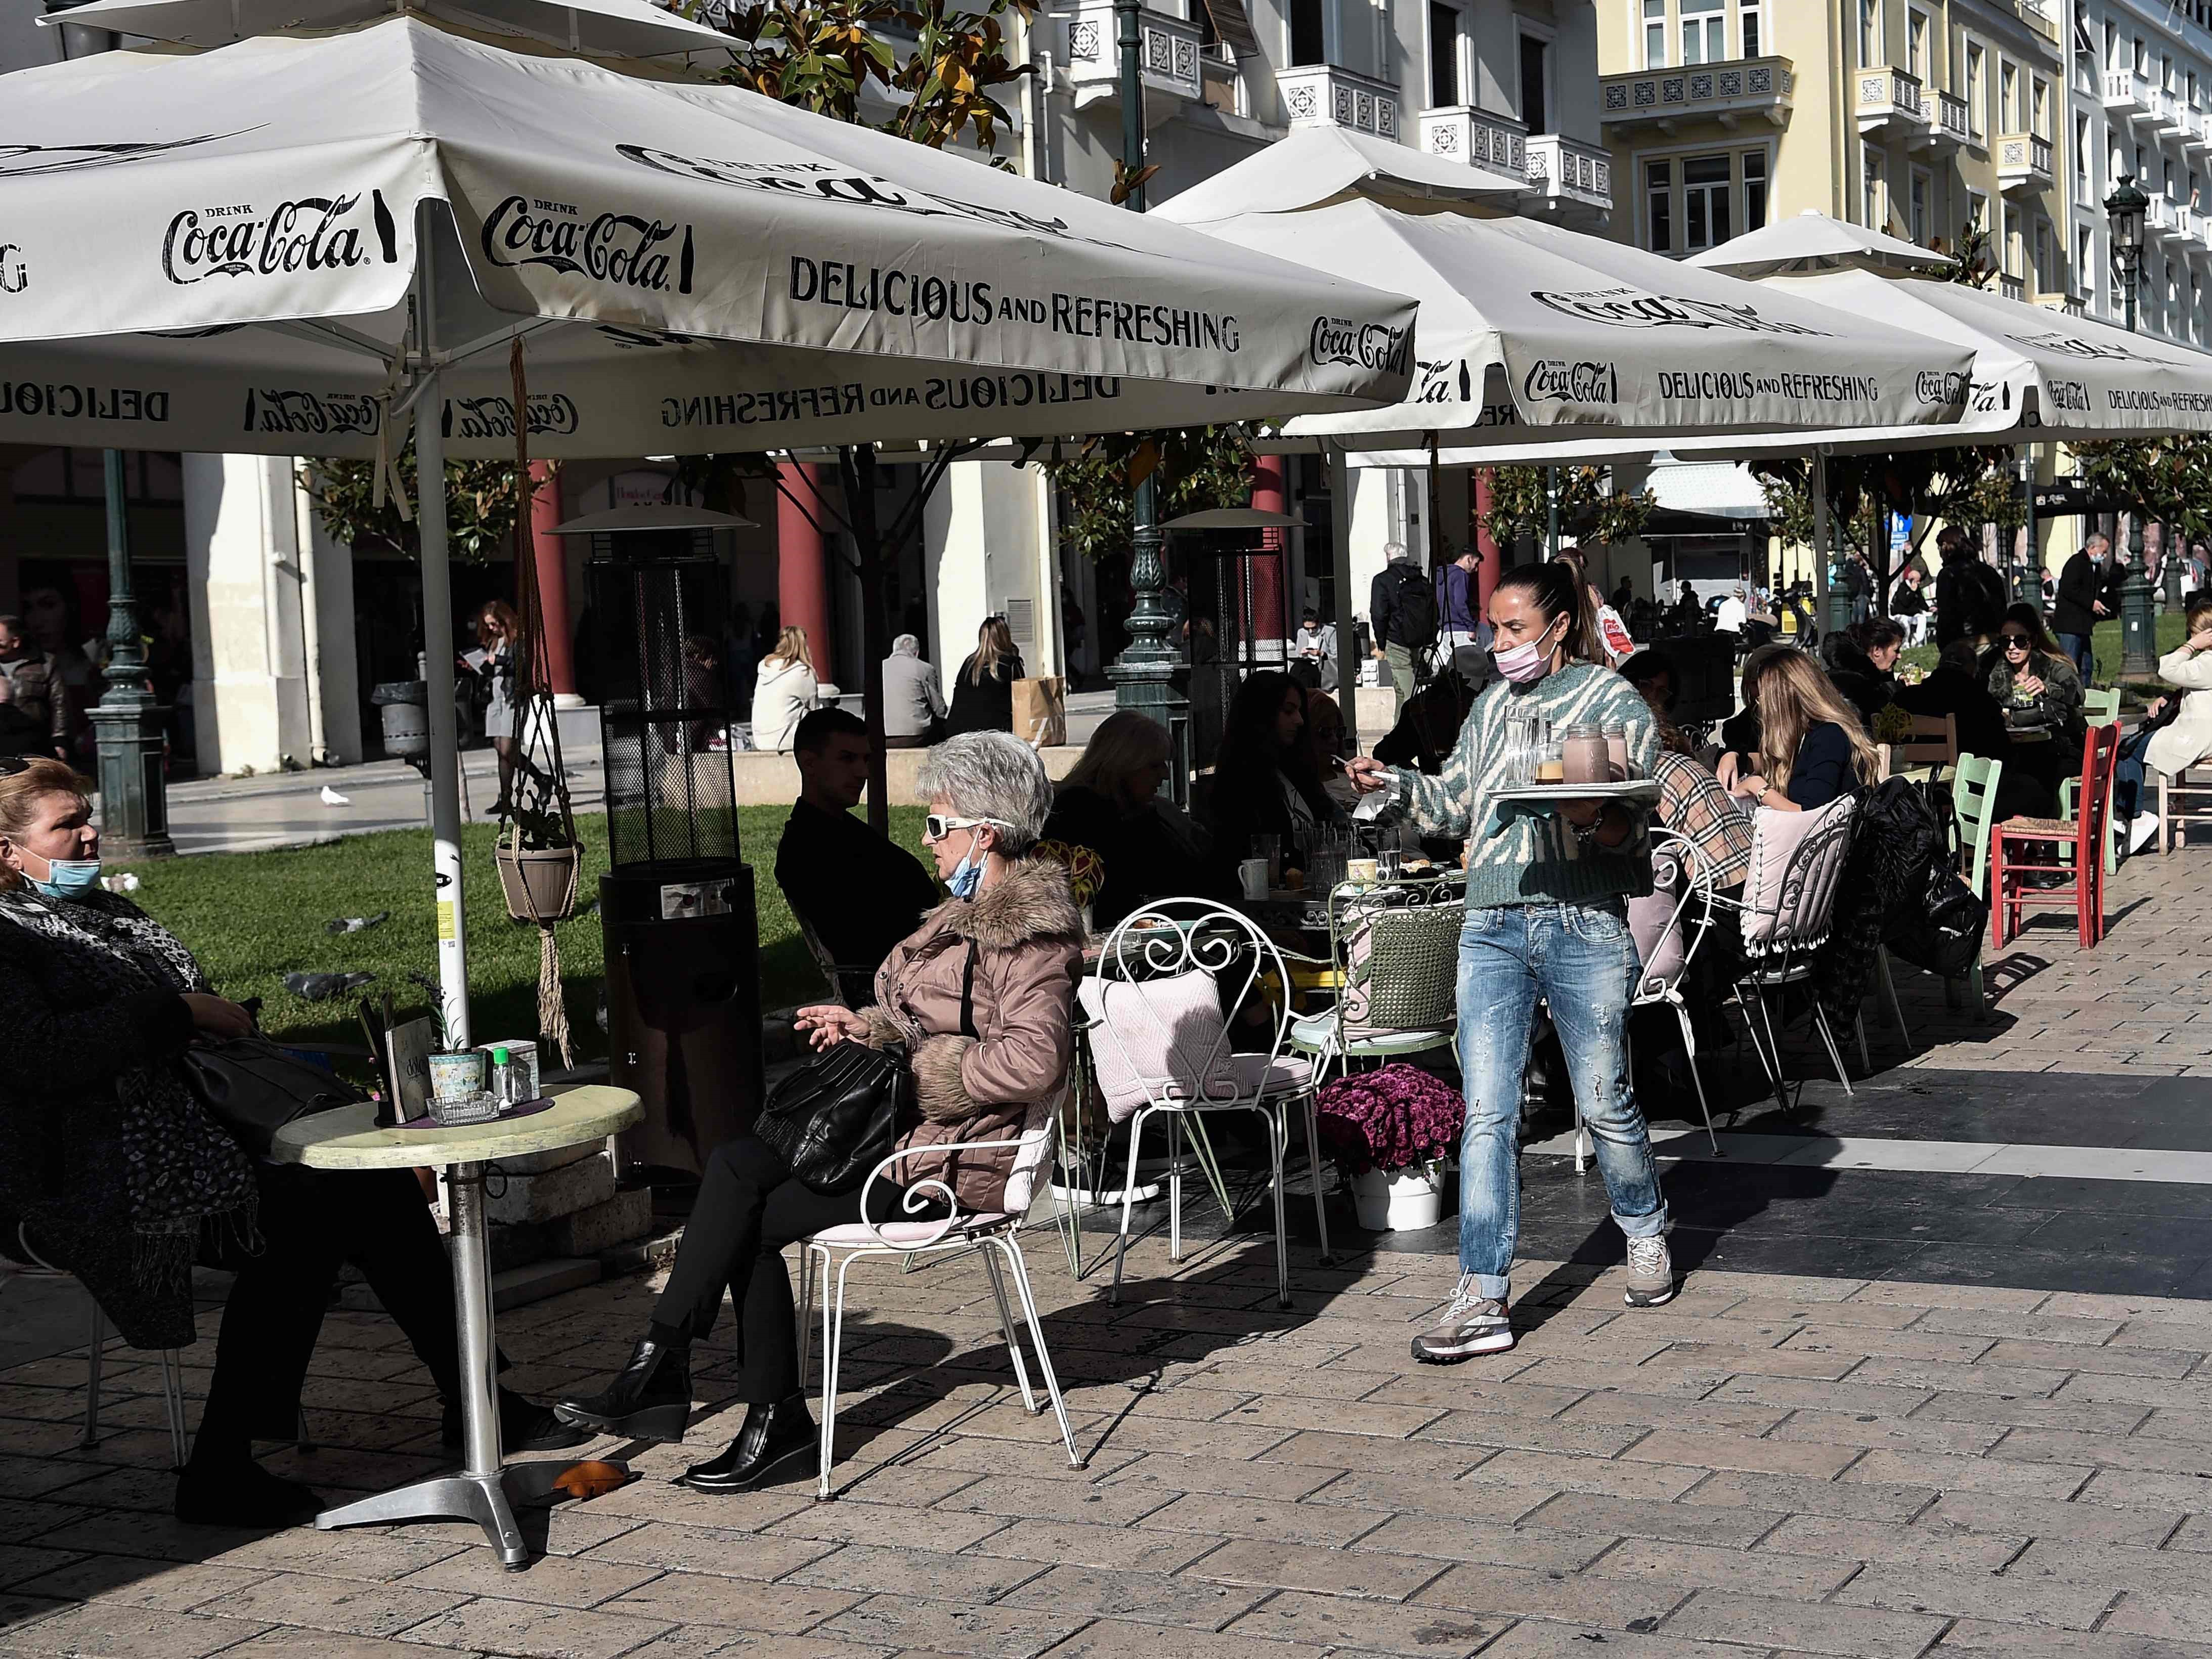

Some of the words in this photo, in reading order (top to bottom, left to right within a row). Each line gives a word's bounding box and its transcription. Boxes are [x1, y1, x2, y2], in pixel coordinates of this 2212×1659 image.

[204, 204, 253, 217] DRINK
[534, 198, 579, 216] DRINK
[162, 192, 364, 284] Coca-Cola
[481, 195, 677, 290] Coca-Cola
[790, 255, 993, 325] DELICIOUS
[997, 296, 1047, 324] AND
[1052, 292, 1240, 353] REFRESHING
[1331, 317, 1353, 327] DRINK
[1524, 360, 1608, 404] Coca-Cola
[1658, 372, 1754, 400] DELICIOUS
[1756, 378, 1781, 394] AND
[1780, 372, 1879, 402] REFRESHING
[2108, 390, 2159, 410] DELICIOUS
[2160, 396, 2173, 407] AND
